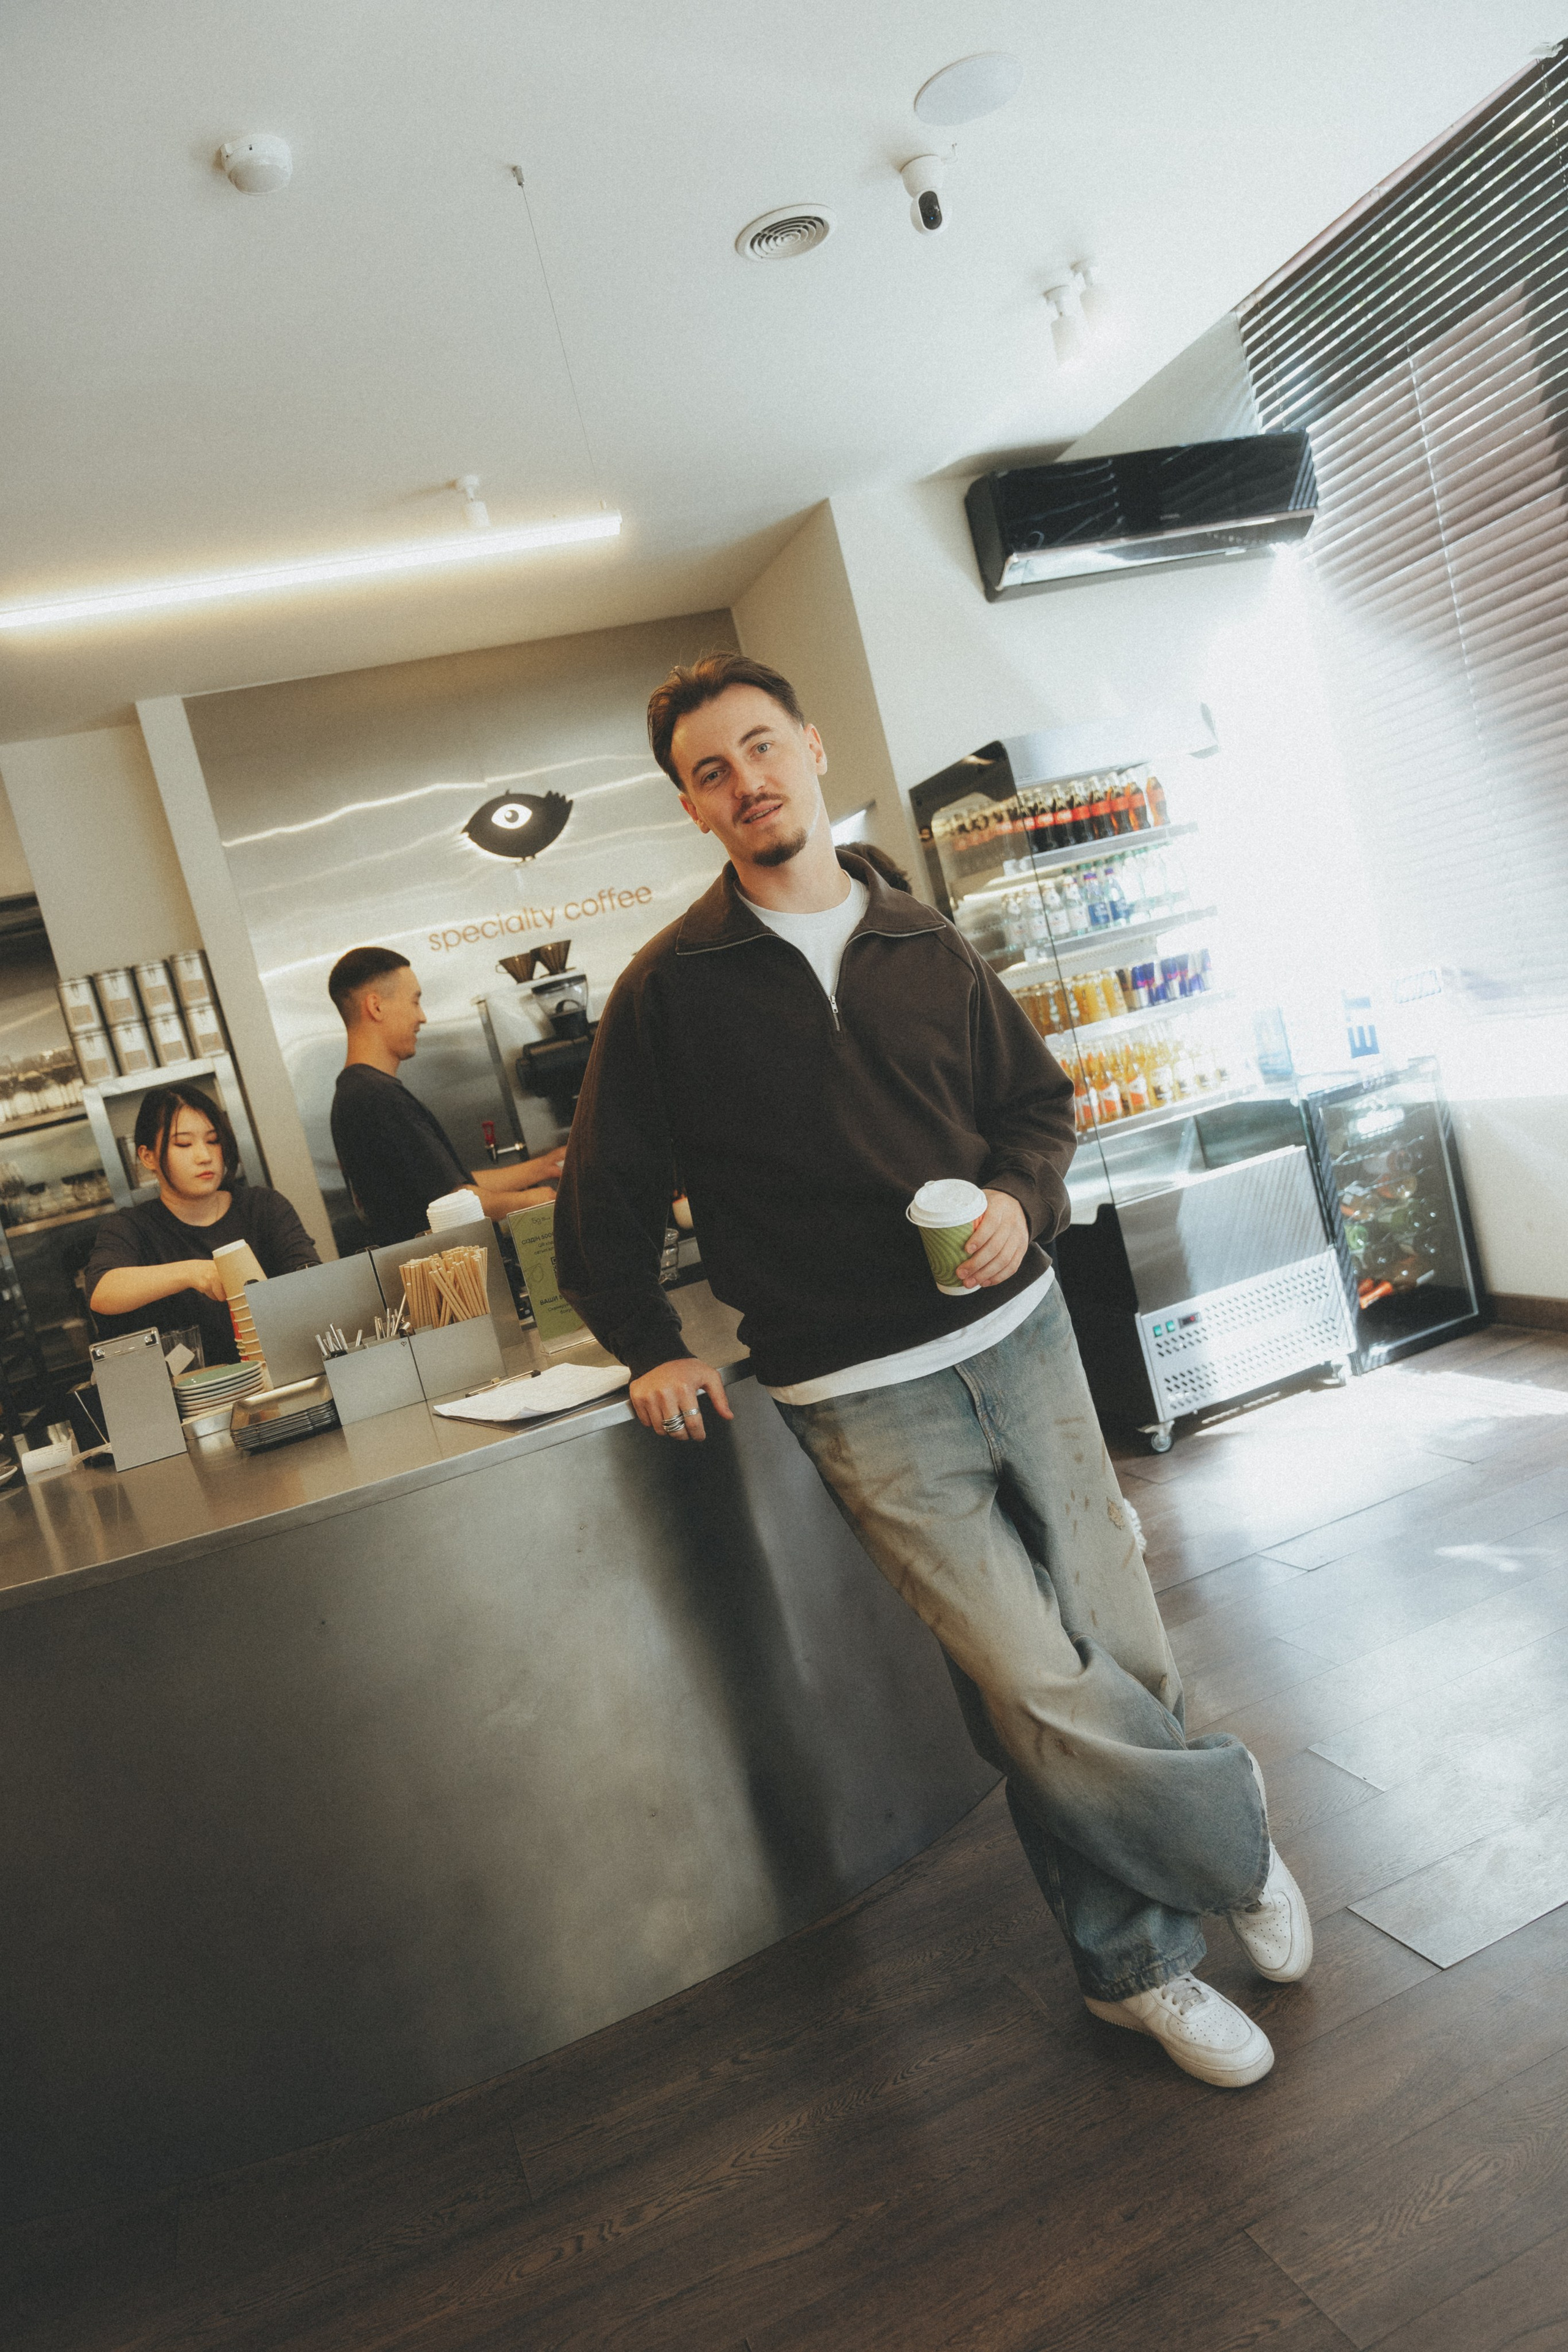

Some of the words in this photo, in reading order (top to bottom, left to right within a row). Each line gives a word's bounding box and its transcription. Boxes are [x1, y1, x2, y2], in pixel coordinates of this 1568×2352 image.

[428, 907, 556, 952] specialty
[564, 886, 652, 921] coffee
[540, 1295, 558, 1305] ВАШИ
